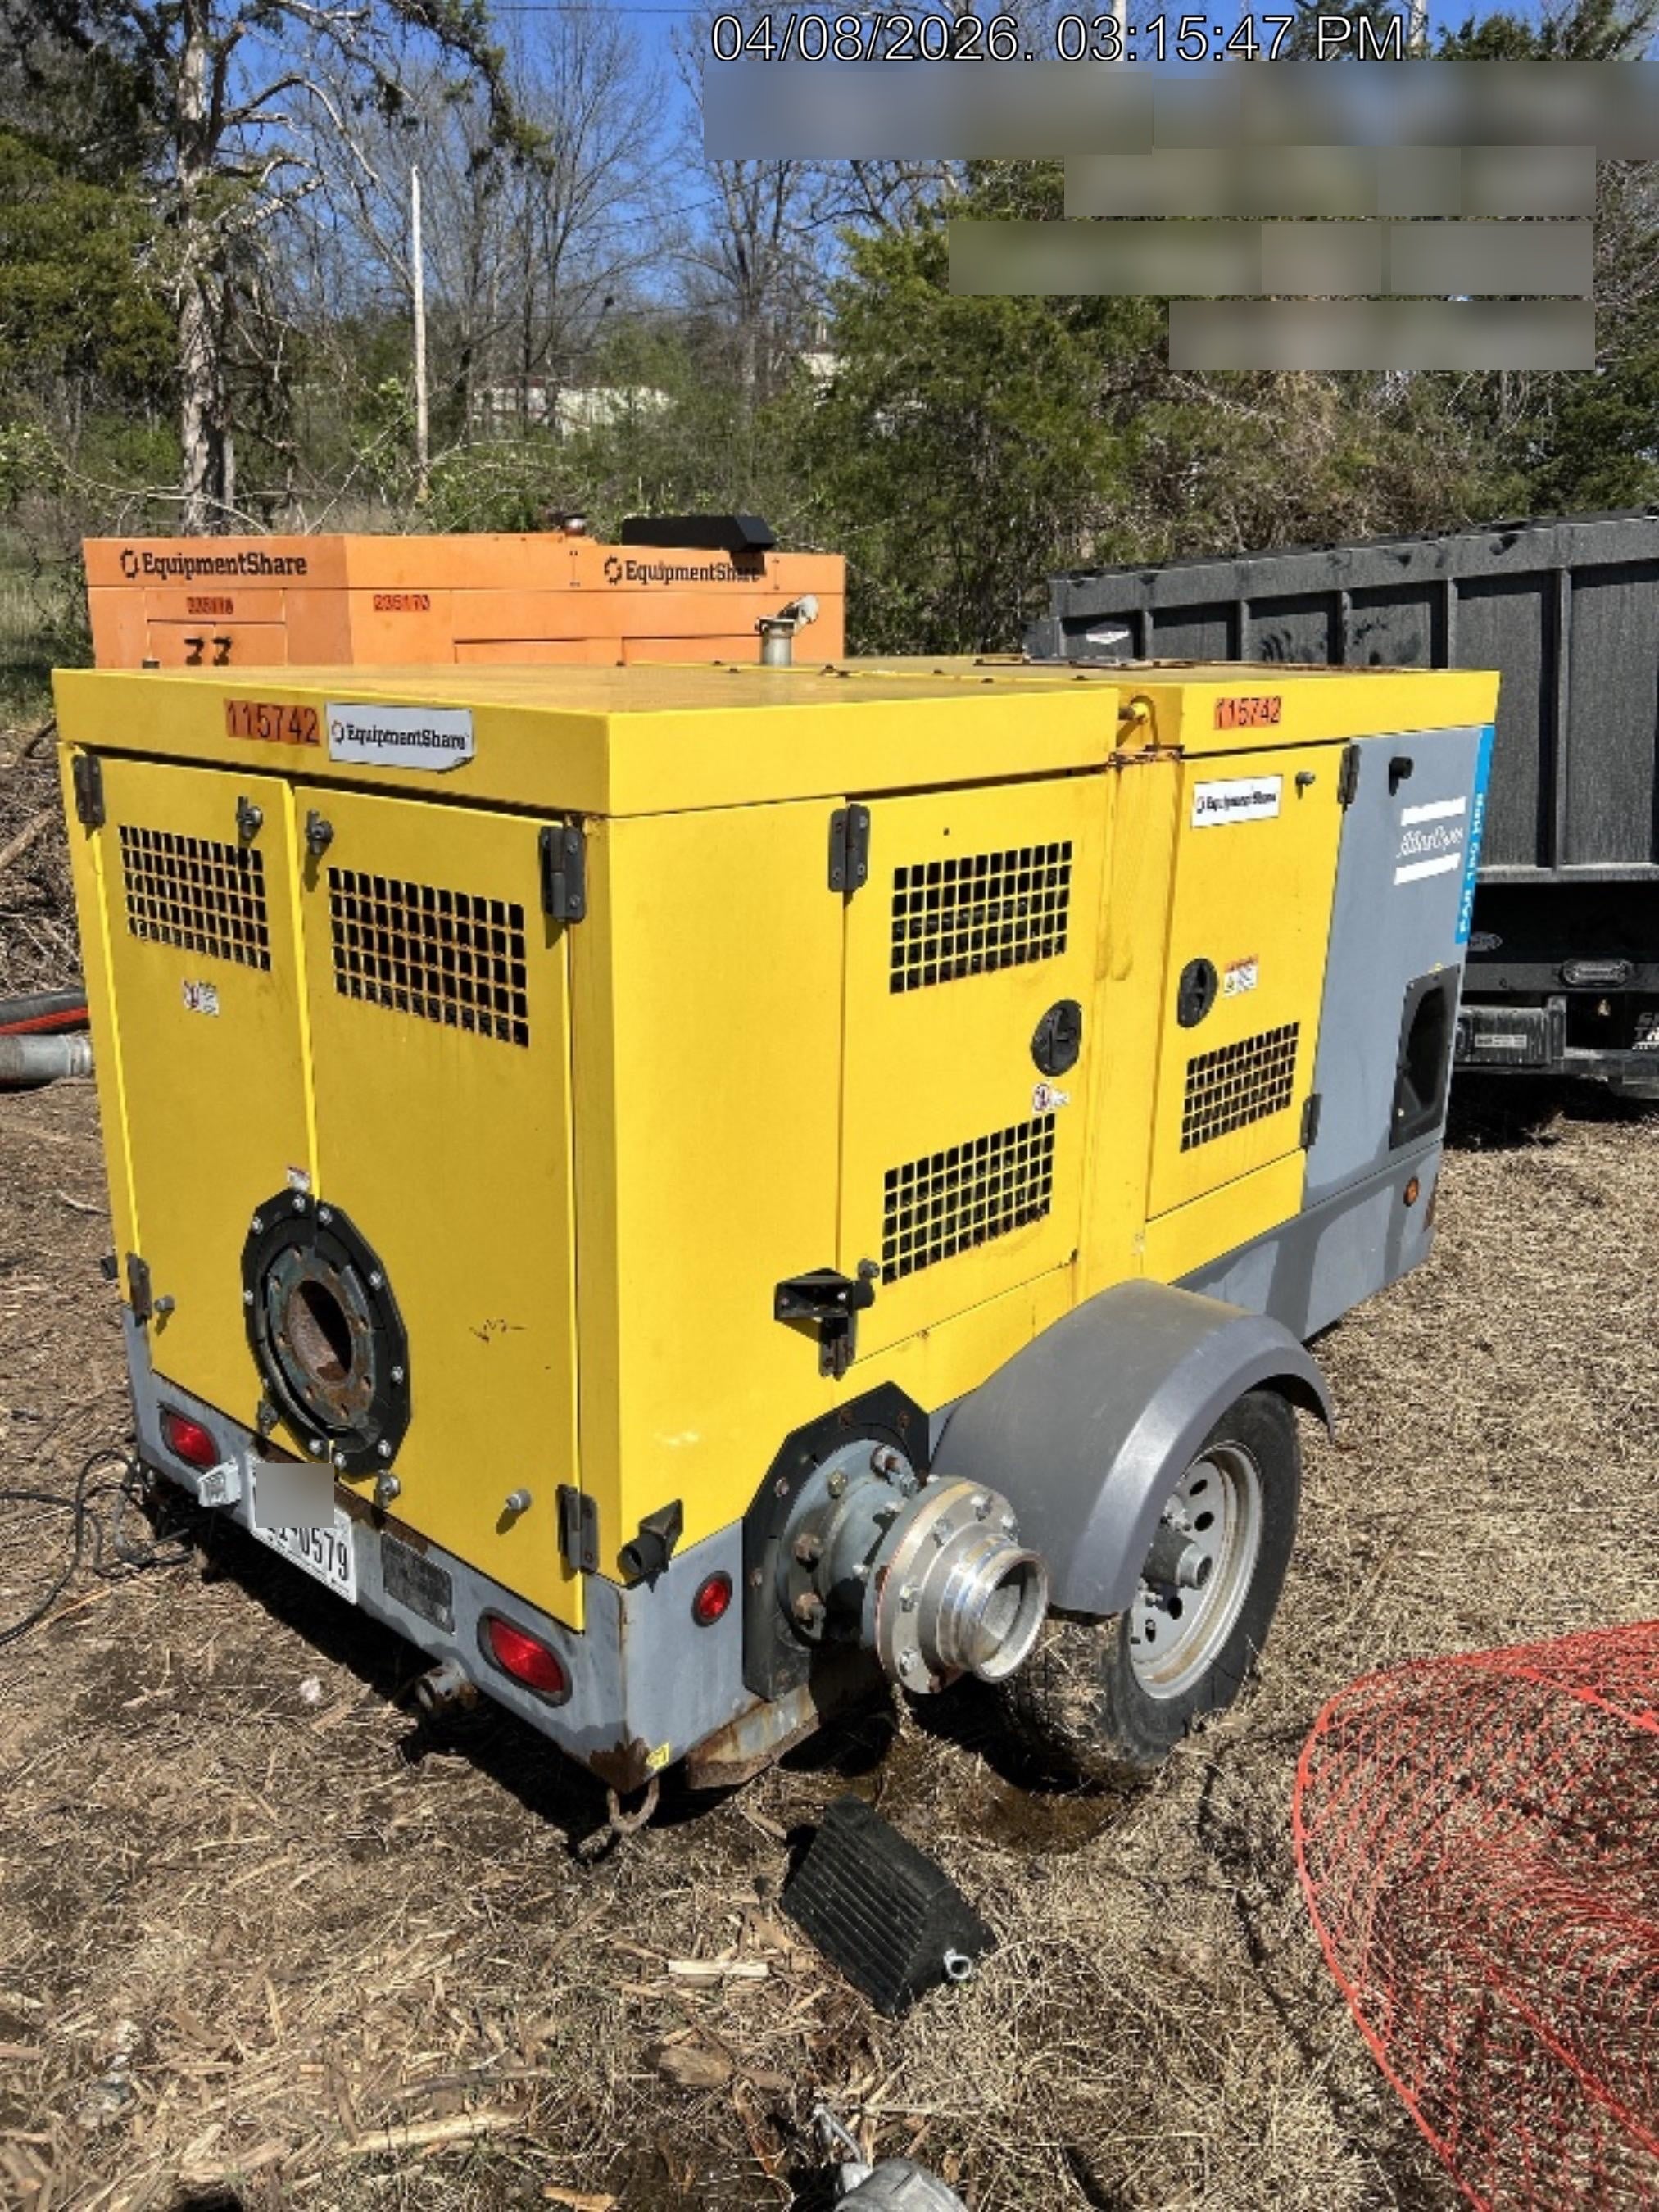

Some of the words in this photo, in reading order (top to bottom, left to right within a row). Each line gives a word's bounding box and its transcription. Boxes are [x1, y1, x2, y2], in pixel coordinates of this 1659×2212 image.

[143, 552, 307, 580] EquipmentShare
[227, 704, 320, 744] 115742
[1217, 696, 1281, 728] 115742
